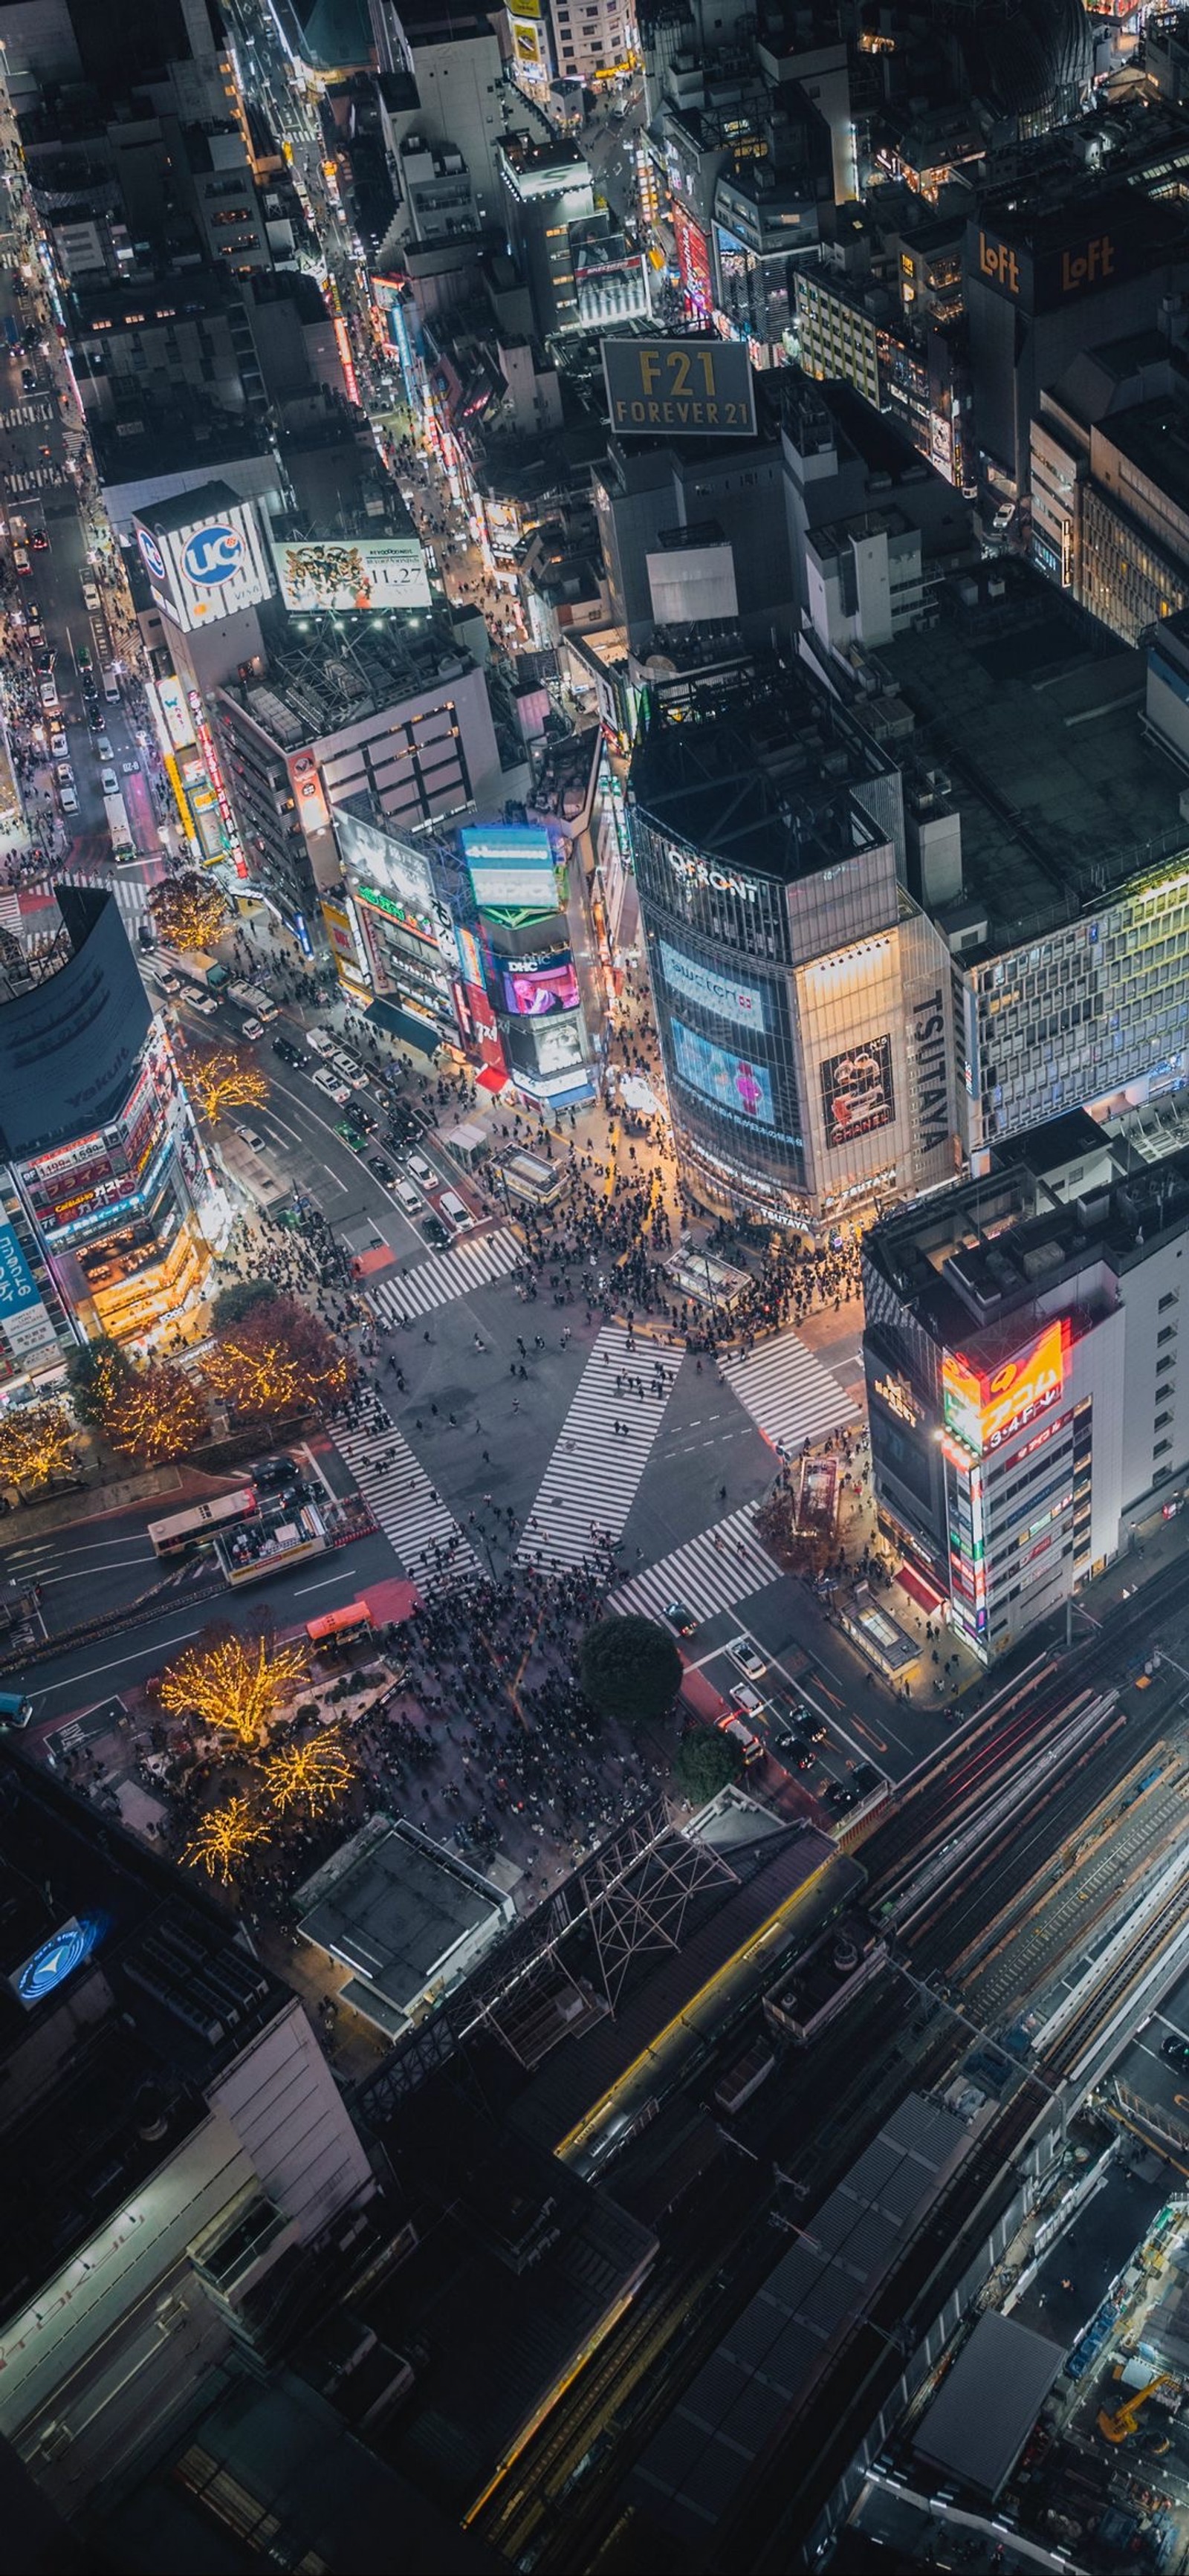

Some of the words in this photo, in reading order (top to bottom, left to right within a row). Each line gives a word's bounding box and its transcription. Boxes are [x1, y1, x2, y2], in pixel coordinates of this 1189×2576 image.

[639, 351, 716, 396] F21
[616, 401, 719, 424] FOREVER
[726, 403, 748, 424] 21
[187, 534, 240, 576] UC
[372, 568, 421, 583] 11.27
[668, 851, 757, 903] QFRONT
[508, 961, 538, 973] DHC
[64, 1047, 130, 1109] Yakult
[913, 989, 949, 1154] TSUTAYA
[832, 1115, 890, 1143] CHANEL
[841, 1169, 897, 1199] TSUTAYA
[42, 1219, 56, 1229] 7F
[760, 1207, 809, 1232] TSUTAYA
[986, 1369, 1057, 1435] アコム
